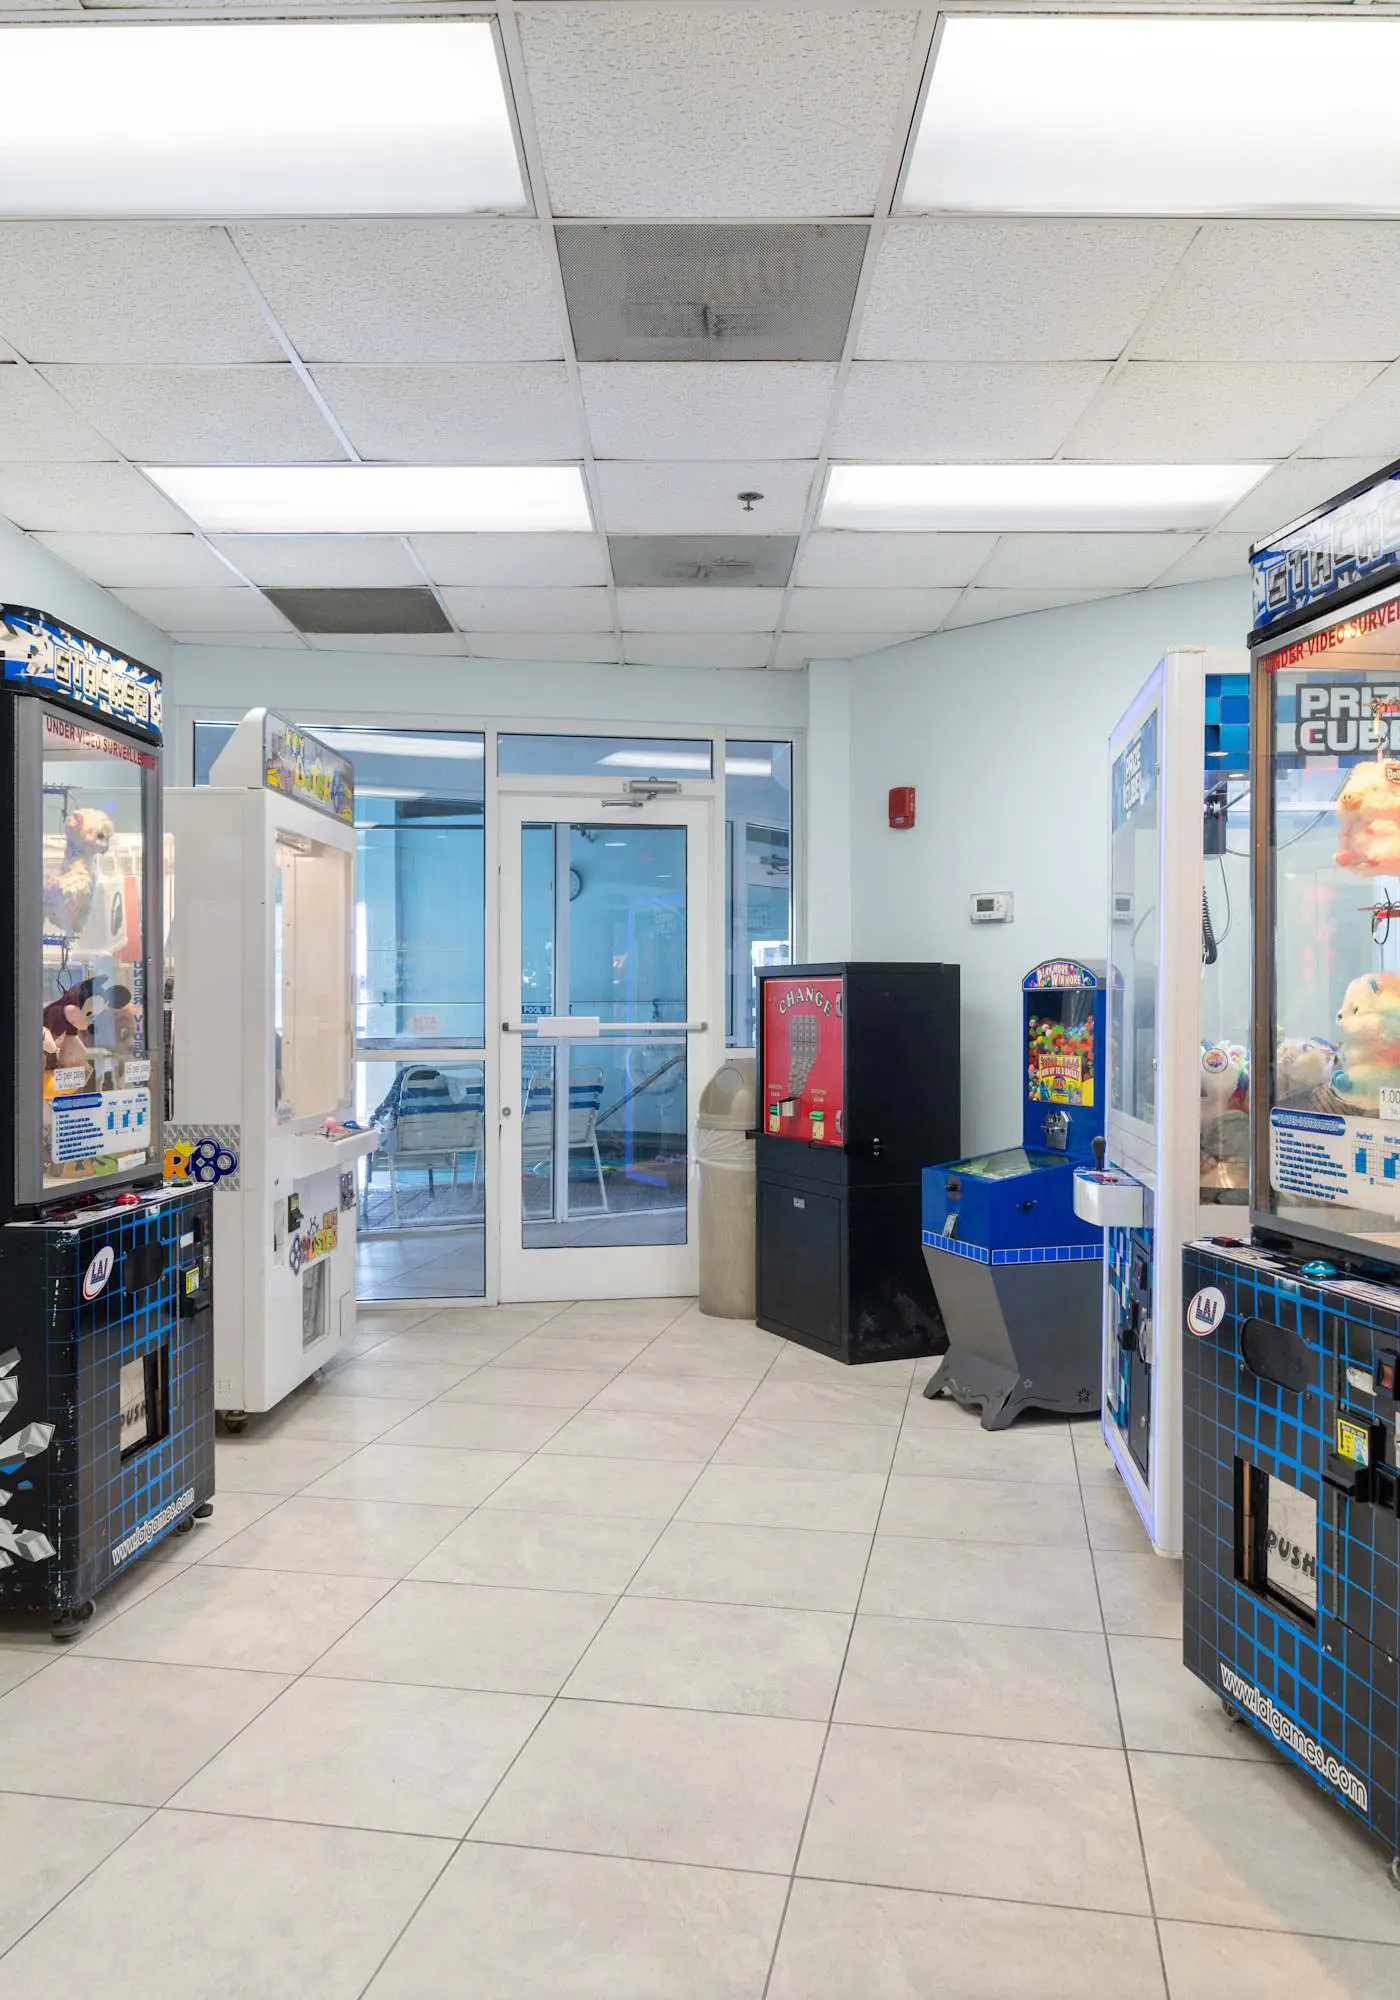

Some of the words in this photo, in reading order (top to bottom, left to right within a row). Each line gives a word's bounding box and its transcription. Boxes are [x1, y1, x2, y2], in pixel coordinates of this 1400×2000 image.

[1264, 640, 1305, 674] UNDER
[1307, 621, 1345, 657] VIDEO
[55, 645, 150, 720] STACKER
[46, 719, 75, 741] UNDER
[77, 729, 101, 751] VIDEO
[523, 1006, 544, 1014] POOL
[778, 985, 833, 1017] CHANGE
[112, 1487, 195, 1566] www.laigames.com
[1267, 1528, 1318, 1579] PUSH
[1219, 1662, 1368, 1812] www.laigames.com
